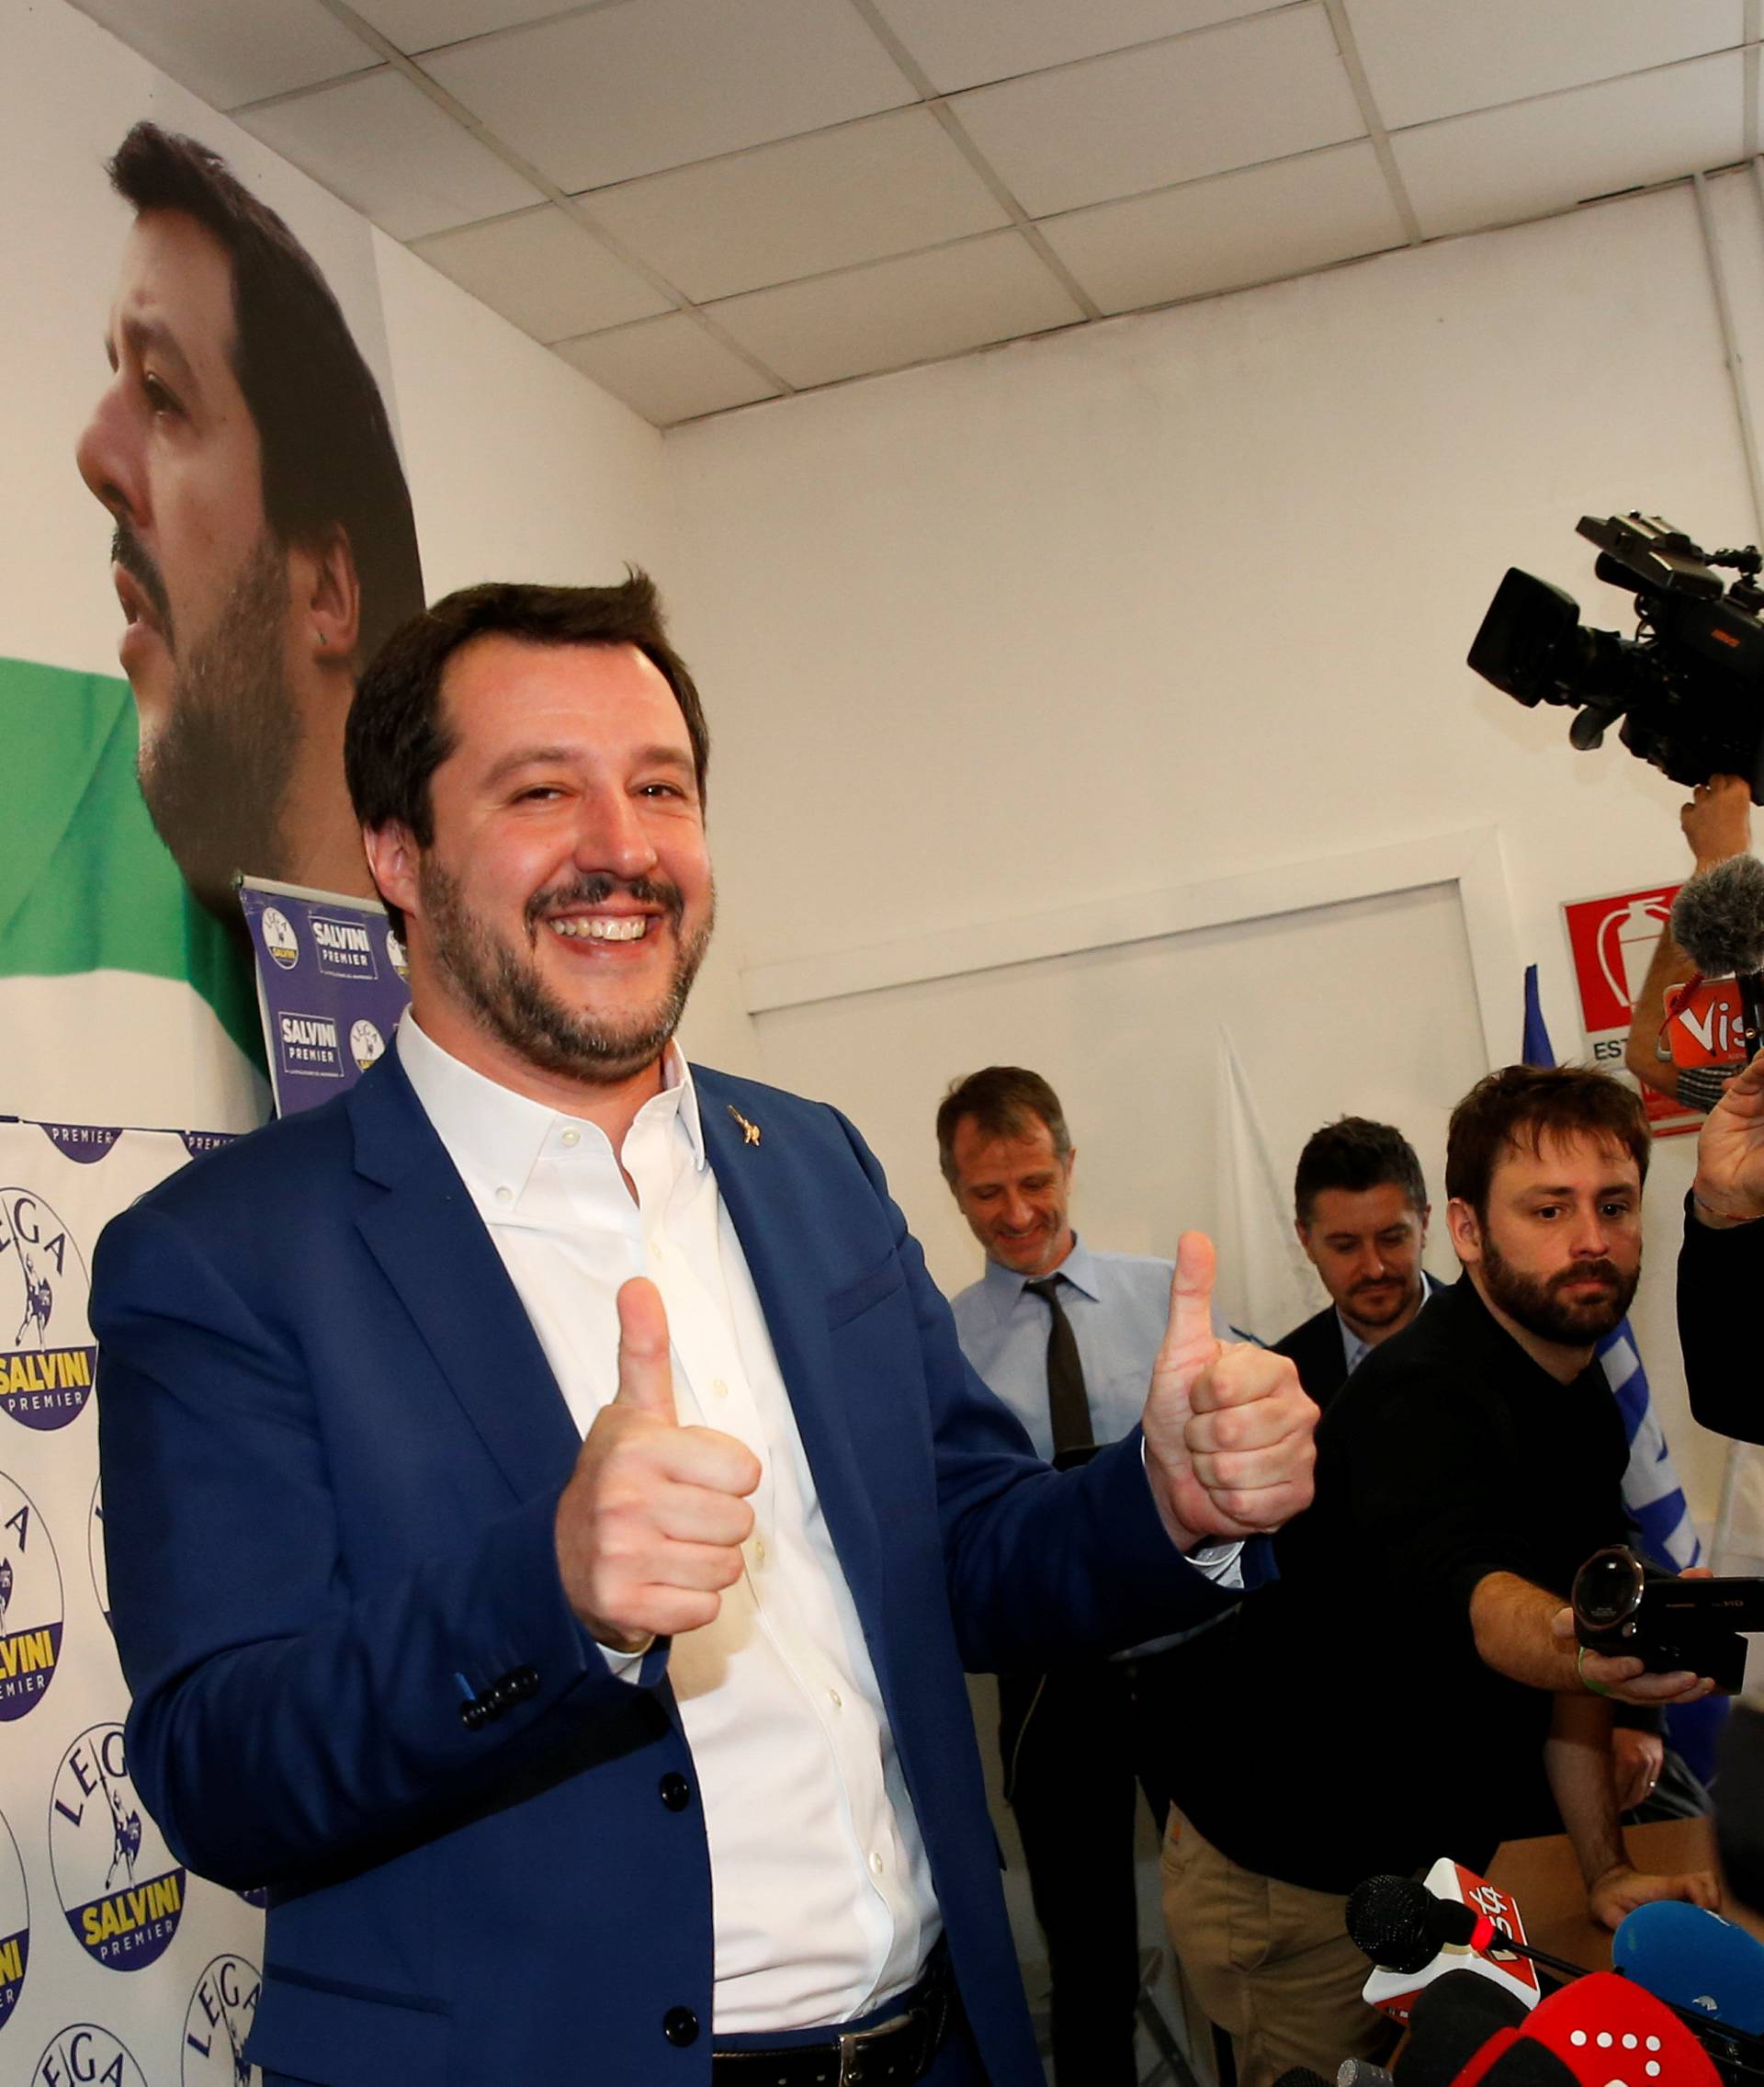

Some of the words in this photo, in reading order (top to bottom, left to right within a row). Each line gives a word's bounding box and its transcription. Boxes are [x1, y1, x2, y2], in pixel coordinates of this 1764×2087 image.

[312, 922, 370, 952] SALVINI
[322, 949, 368, 966] PREMIER
[282, 1018, 336, 1048] SALVINI
[288, 1047, 334, 1062] PREMIER
[1594, 1038, 1628, 1060] ES
[51, 1128, 113, 1144] PREMIER
[8, 1391, 83, 1412] PREMIER
[0, 1630, 54, 1680] VINI
[82, 1875, 182, 1945] SALVINI
[100, 1920, 174, 1960] PREMIER
